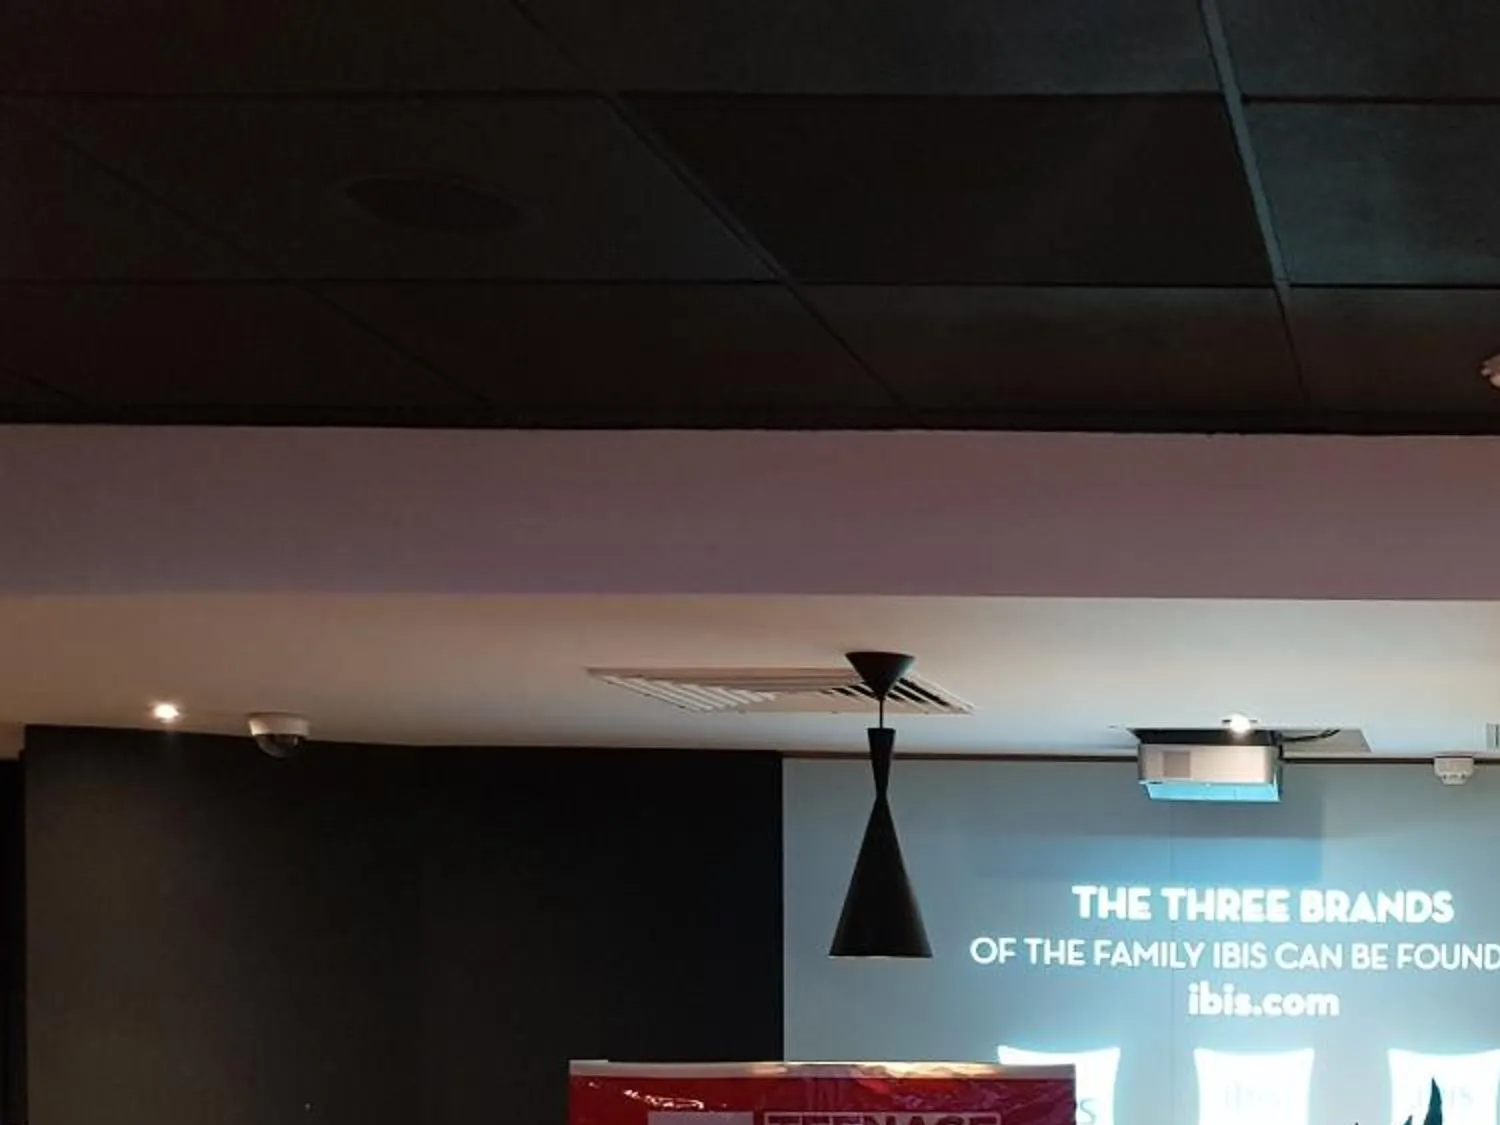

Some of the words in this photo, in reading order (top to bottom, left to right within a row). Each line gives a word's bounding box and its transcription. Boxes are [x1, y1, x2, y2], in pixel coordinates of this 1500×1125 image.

[1071, 885, 1152, 920] THE
[1160, 887, 1291, 923] THREE
[1299, 889, 1455, 924] BRANDS
[970, 936, 1017, 965] OF
[1023, 937, 1086, 966] THE
[1094, 939, 1206, 969] FAMILY
[1212, 941, 1268, 970] IBIS
[1274, 941, 1343, 971] CAN
[1351, 942, 1389, 971] BE
[1188, 980, 1341, 1017] ibis.com
